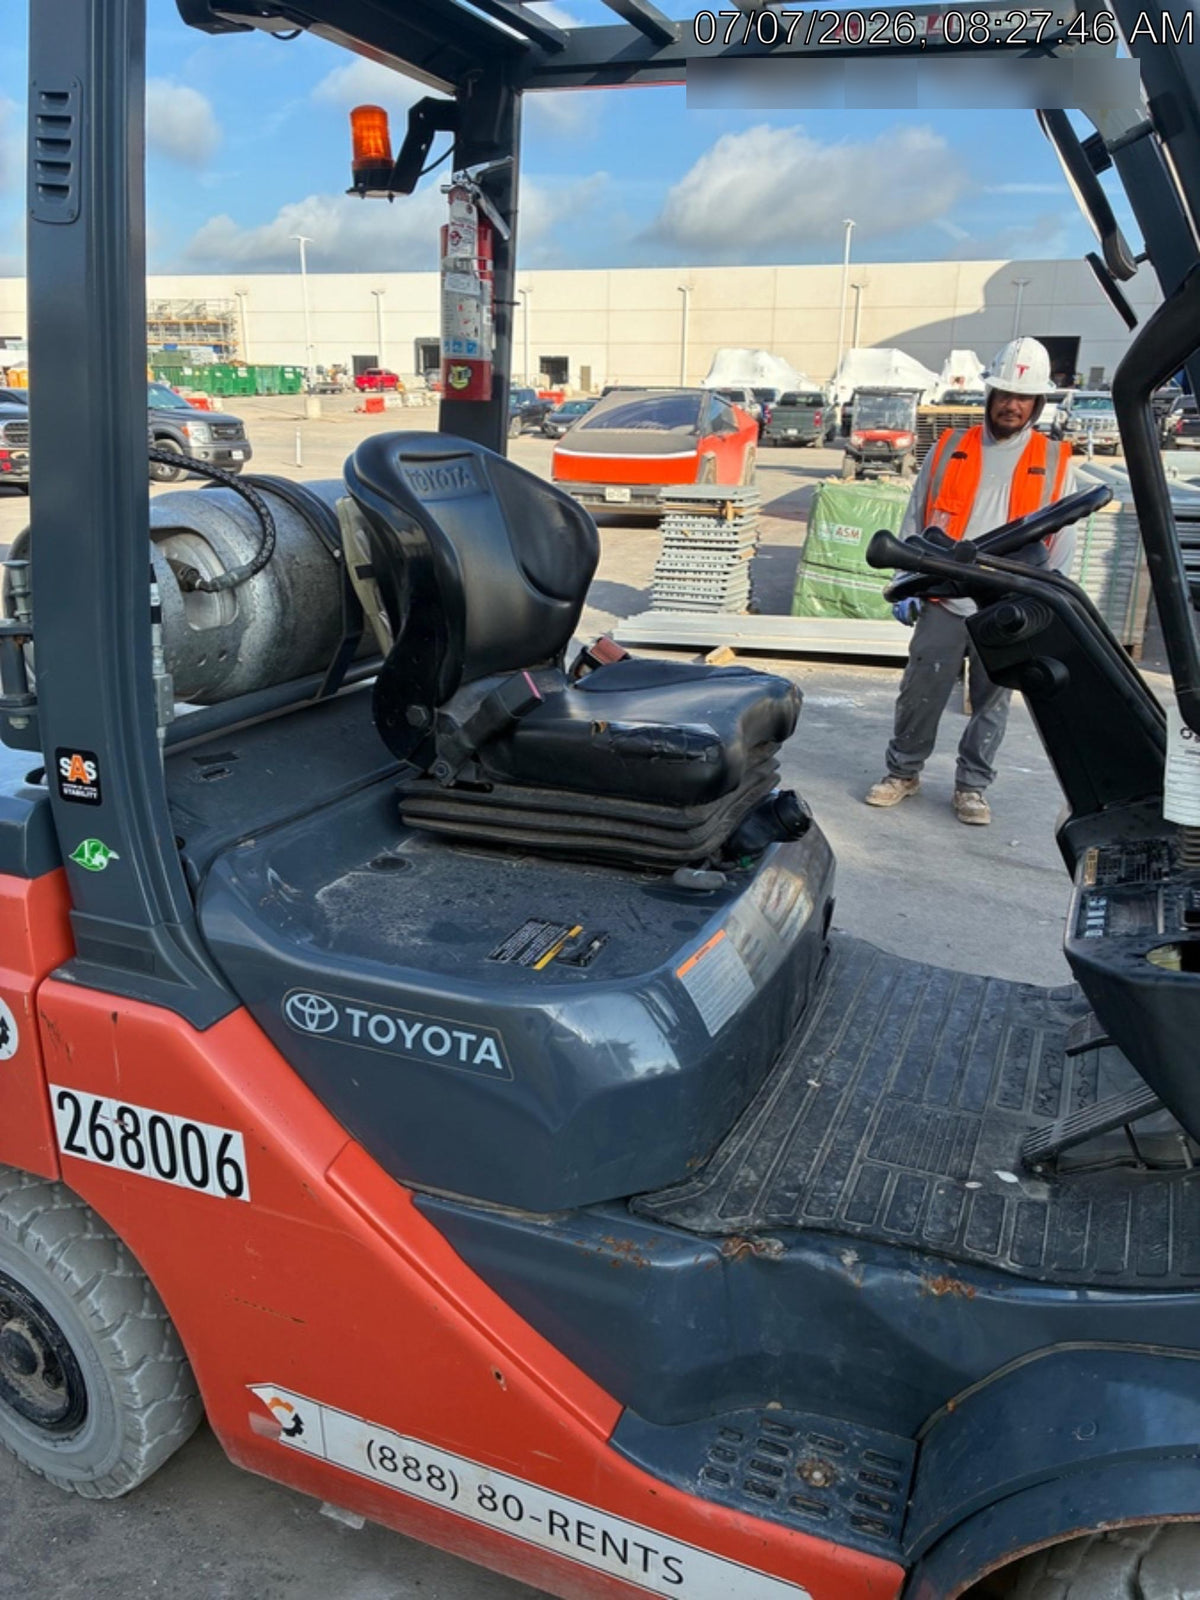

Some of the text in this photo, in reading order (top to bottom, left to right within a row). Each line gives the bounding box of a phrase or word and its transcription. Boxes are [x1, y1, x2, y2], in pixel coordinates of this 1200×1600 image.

[404, 464, 477, 494] TOYOTA
[834, 525, 860, 540] ASM
[59, 753, 98, 785] SAS
[345, 1007, 503, 1070] TOYOTA
[57, 1090, 244, 1198] 268006
[366, 1438, 684, 1586] (888) 80-RENTS
